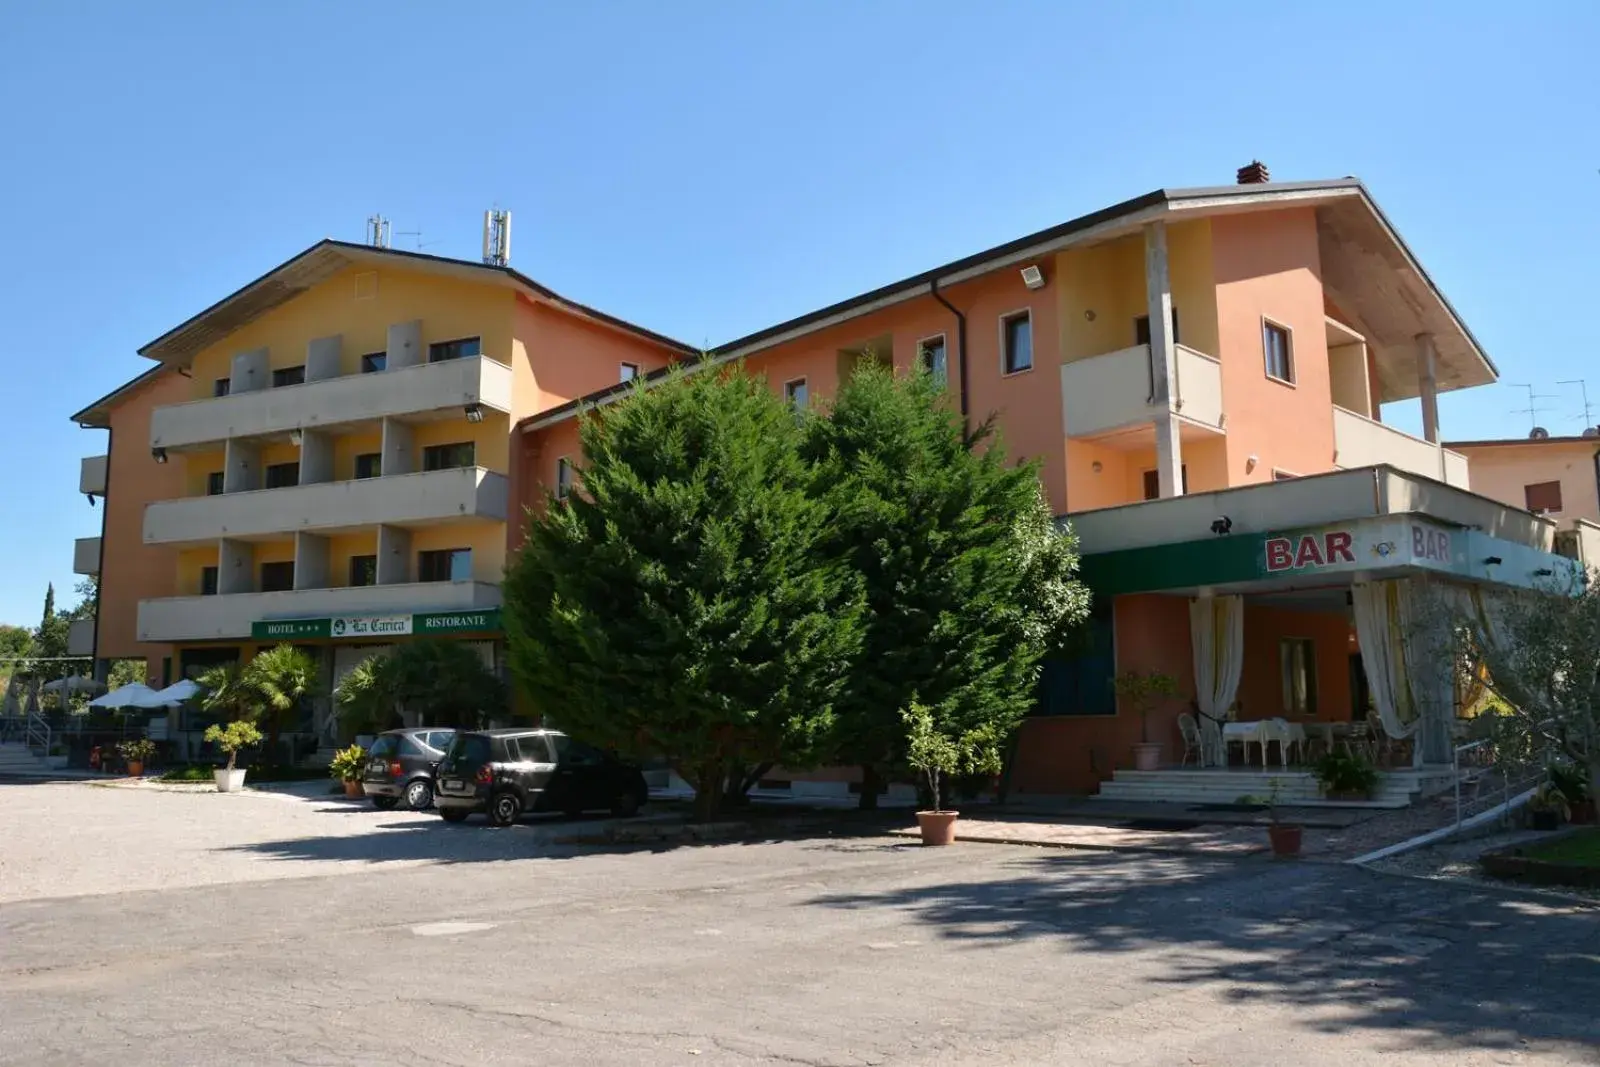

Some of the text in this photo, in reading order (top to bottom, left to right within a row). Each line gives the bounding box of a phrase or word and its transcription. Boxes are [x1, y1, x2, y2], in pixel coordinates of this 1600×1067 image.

[1265, 531, 1355, 572] BAR
[1411, 525, 1450, 562] BAR
[268, 624, 296, 634] HOTEL
[425, 615, 486, 628] RISTORANTE
